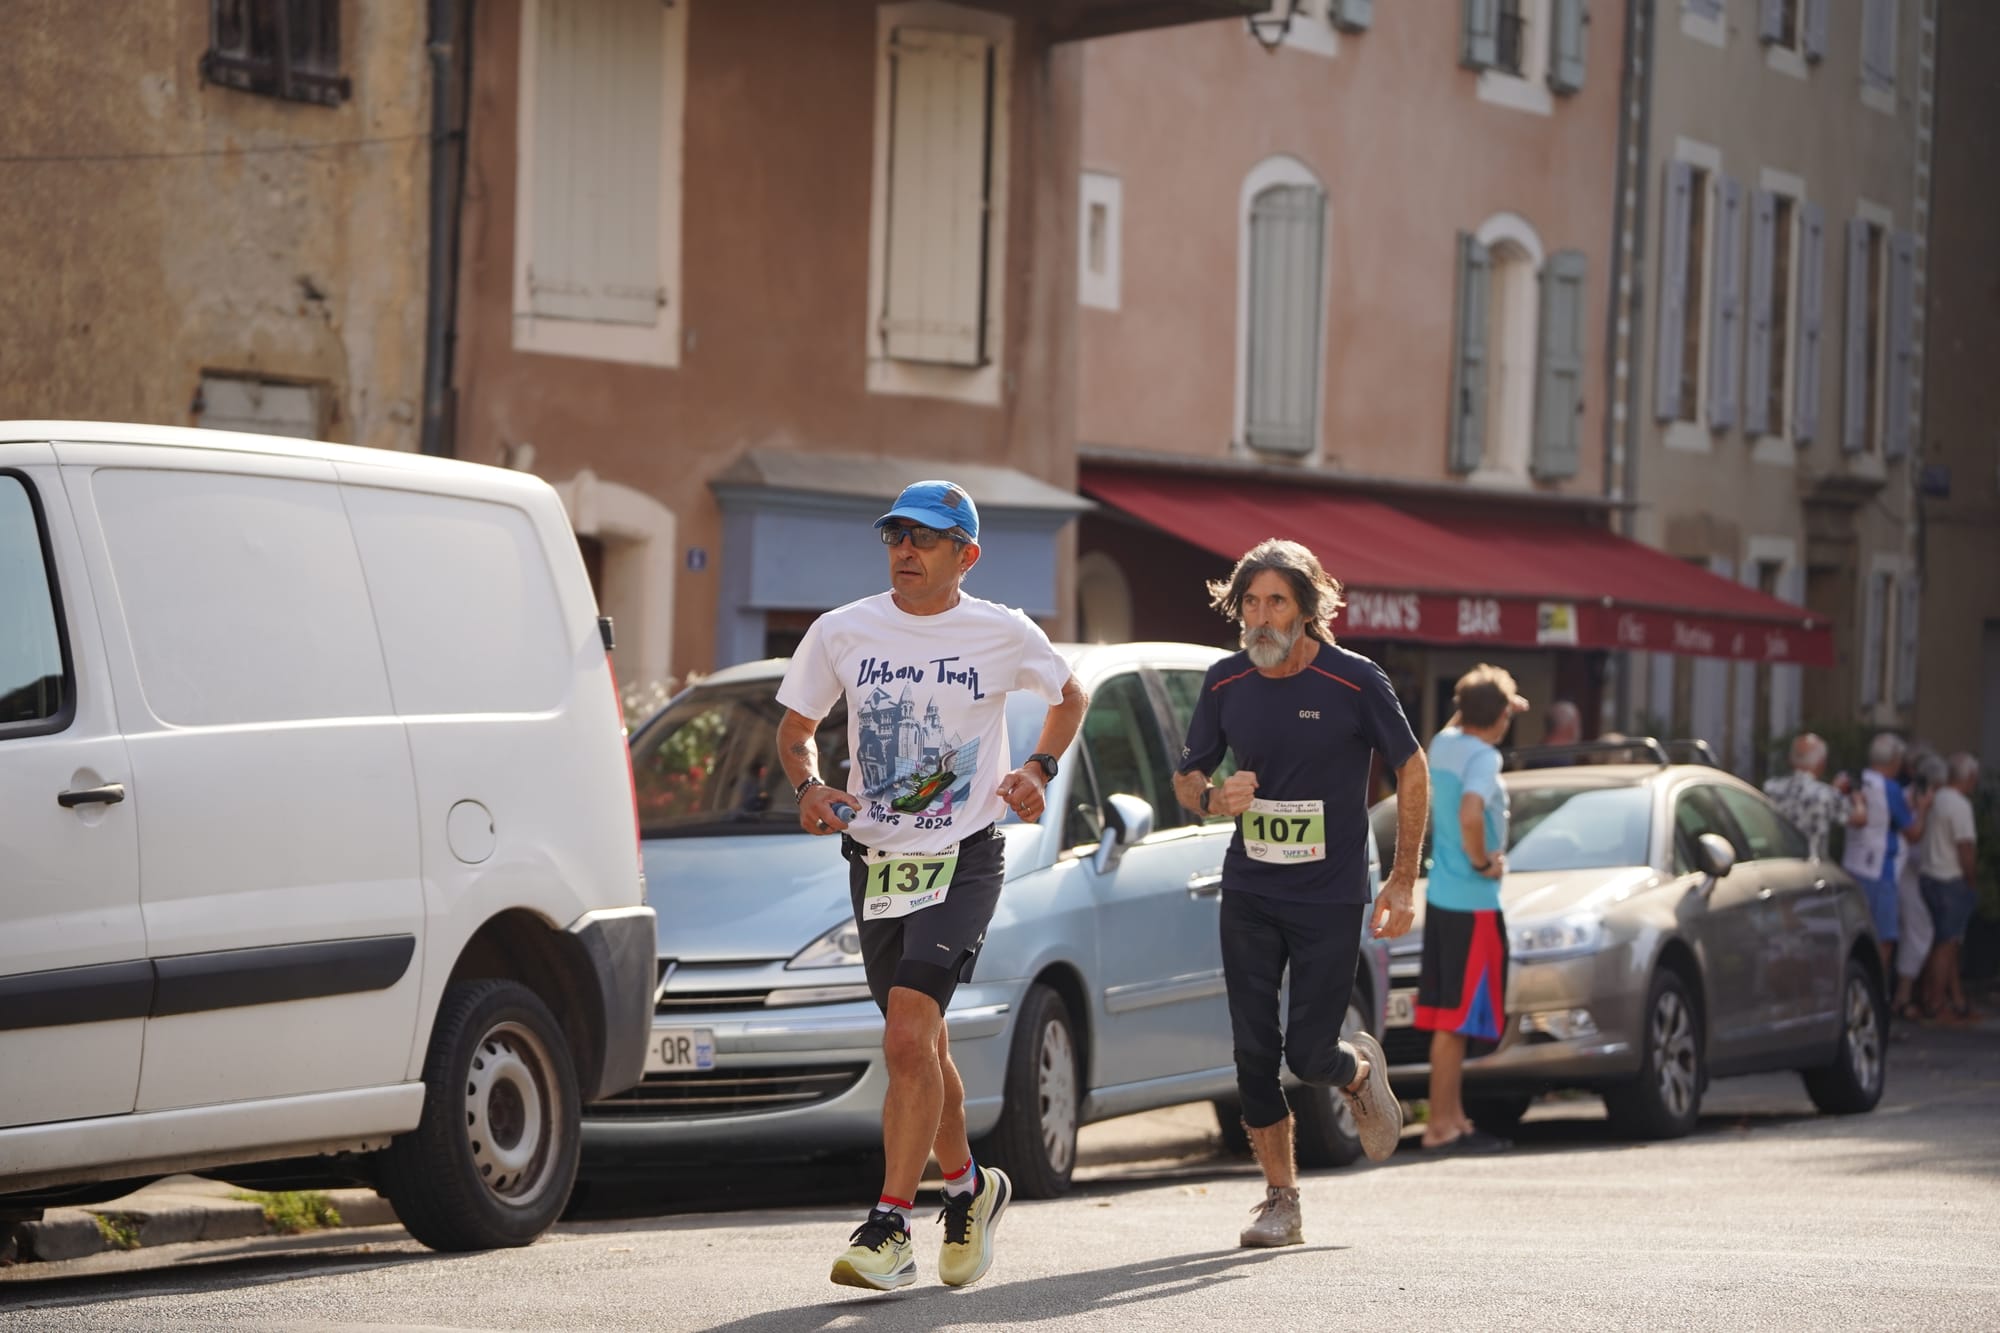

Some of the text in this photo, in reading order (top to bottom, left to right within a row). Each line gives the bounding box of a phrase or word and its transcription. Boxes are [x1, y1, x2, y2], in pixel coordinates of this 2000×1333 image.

[1457, 598, 1500, 634] BAR
[857, 657, 924, 688] Urban
[1299, 710, 1320, 719] GORE
[914, 816, 952, 829] 2024
[1253, 816, 1310, 842] 107
[878, 862, 945, 893] 137
